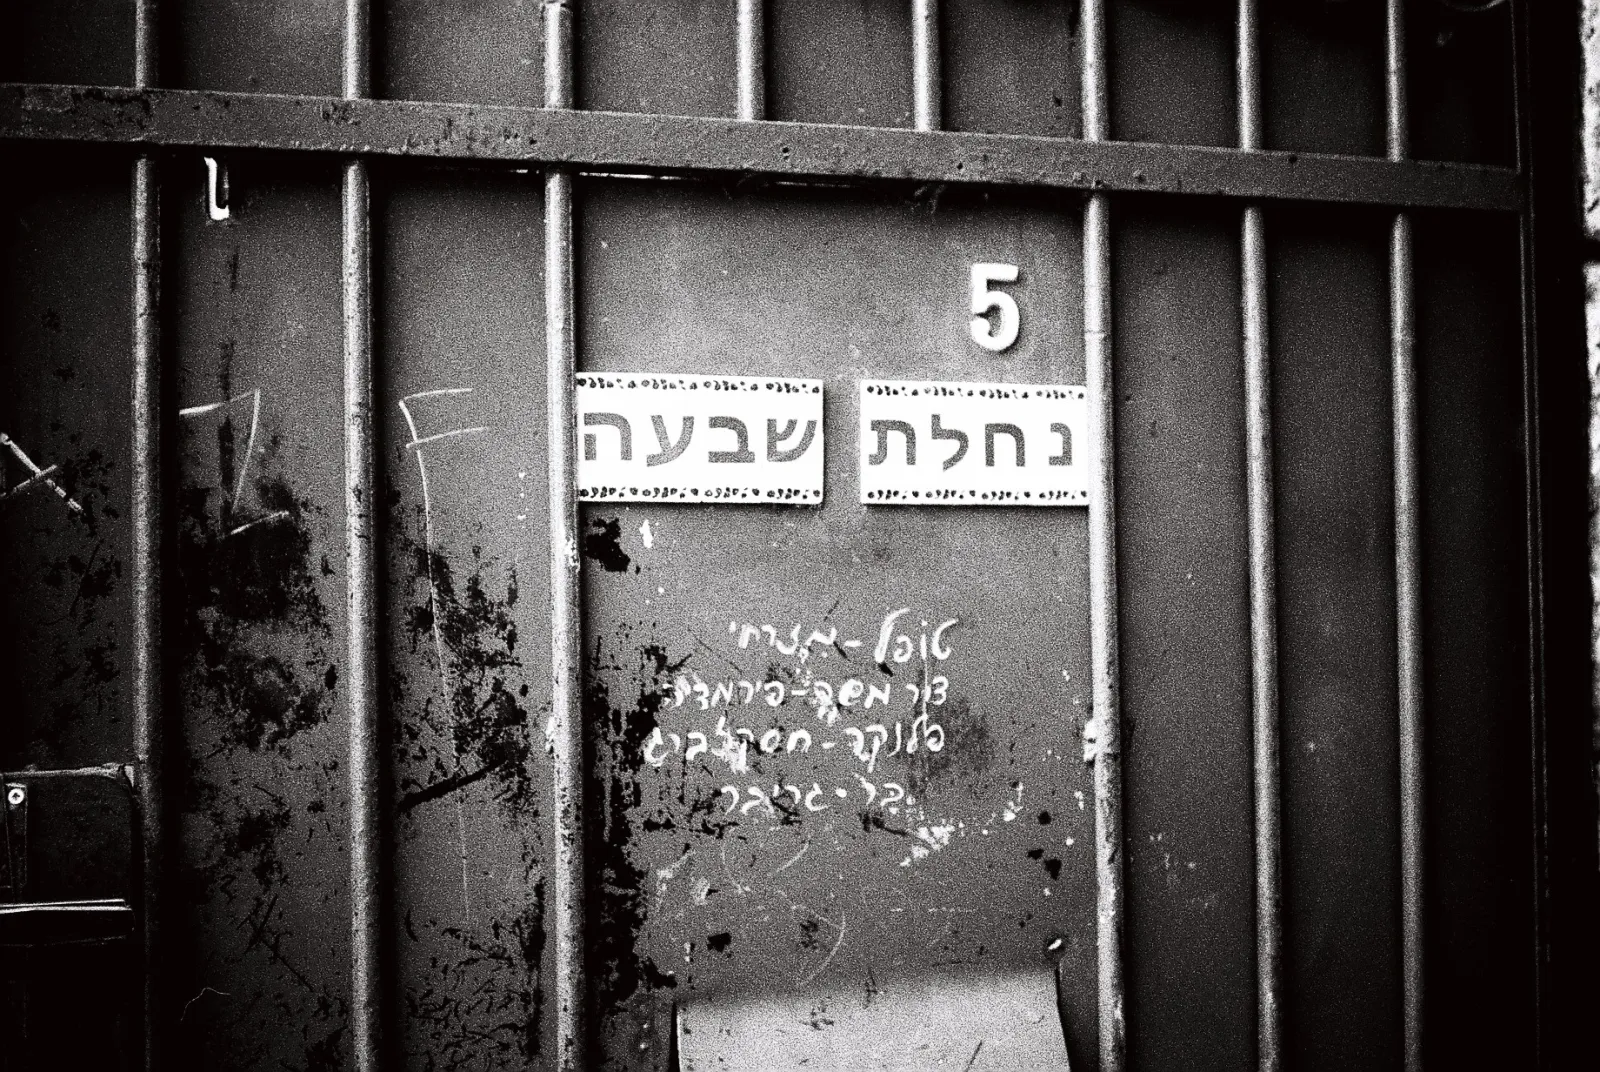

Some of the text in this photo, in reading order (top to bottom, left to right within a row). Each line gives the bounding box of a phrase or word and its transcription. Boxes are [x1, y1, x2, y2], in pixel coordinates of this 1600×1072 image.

[969, 262, 1021, 352] 5
[583, 411, 1073, 473] נחלת שבעה
